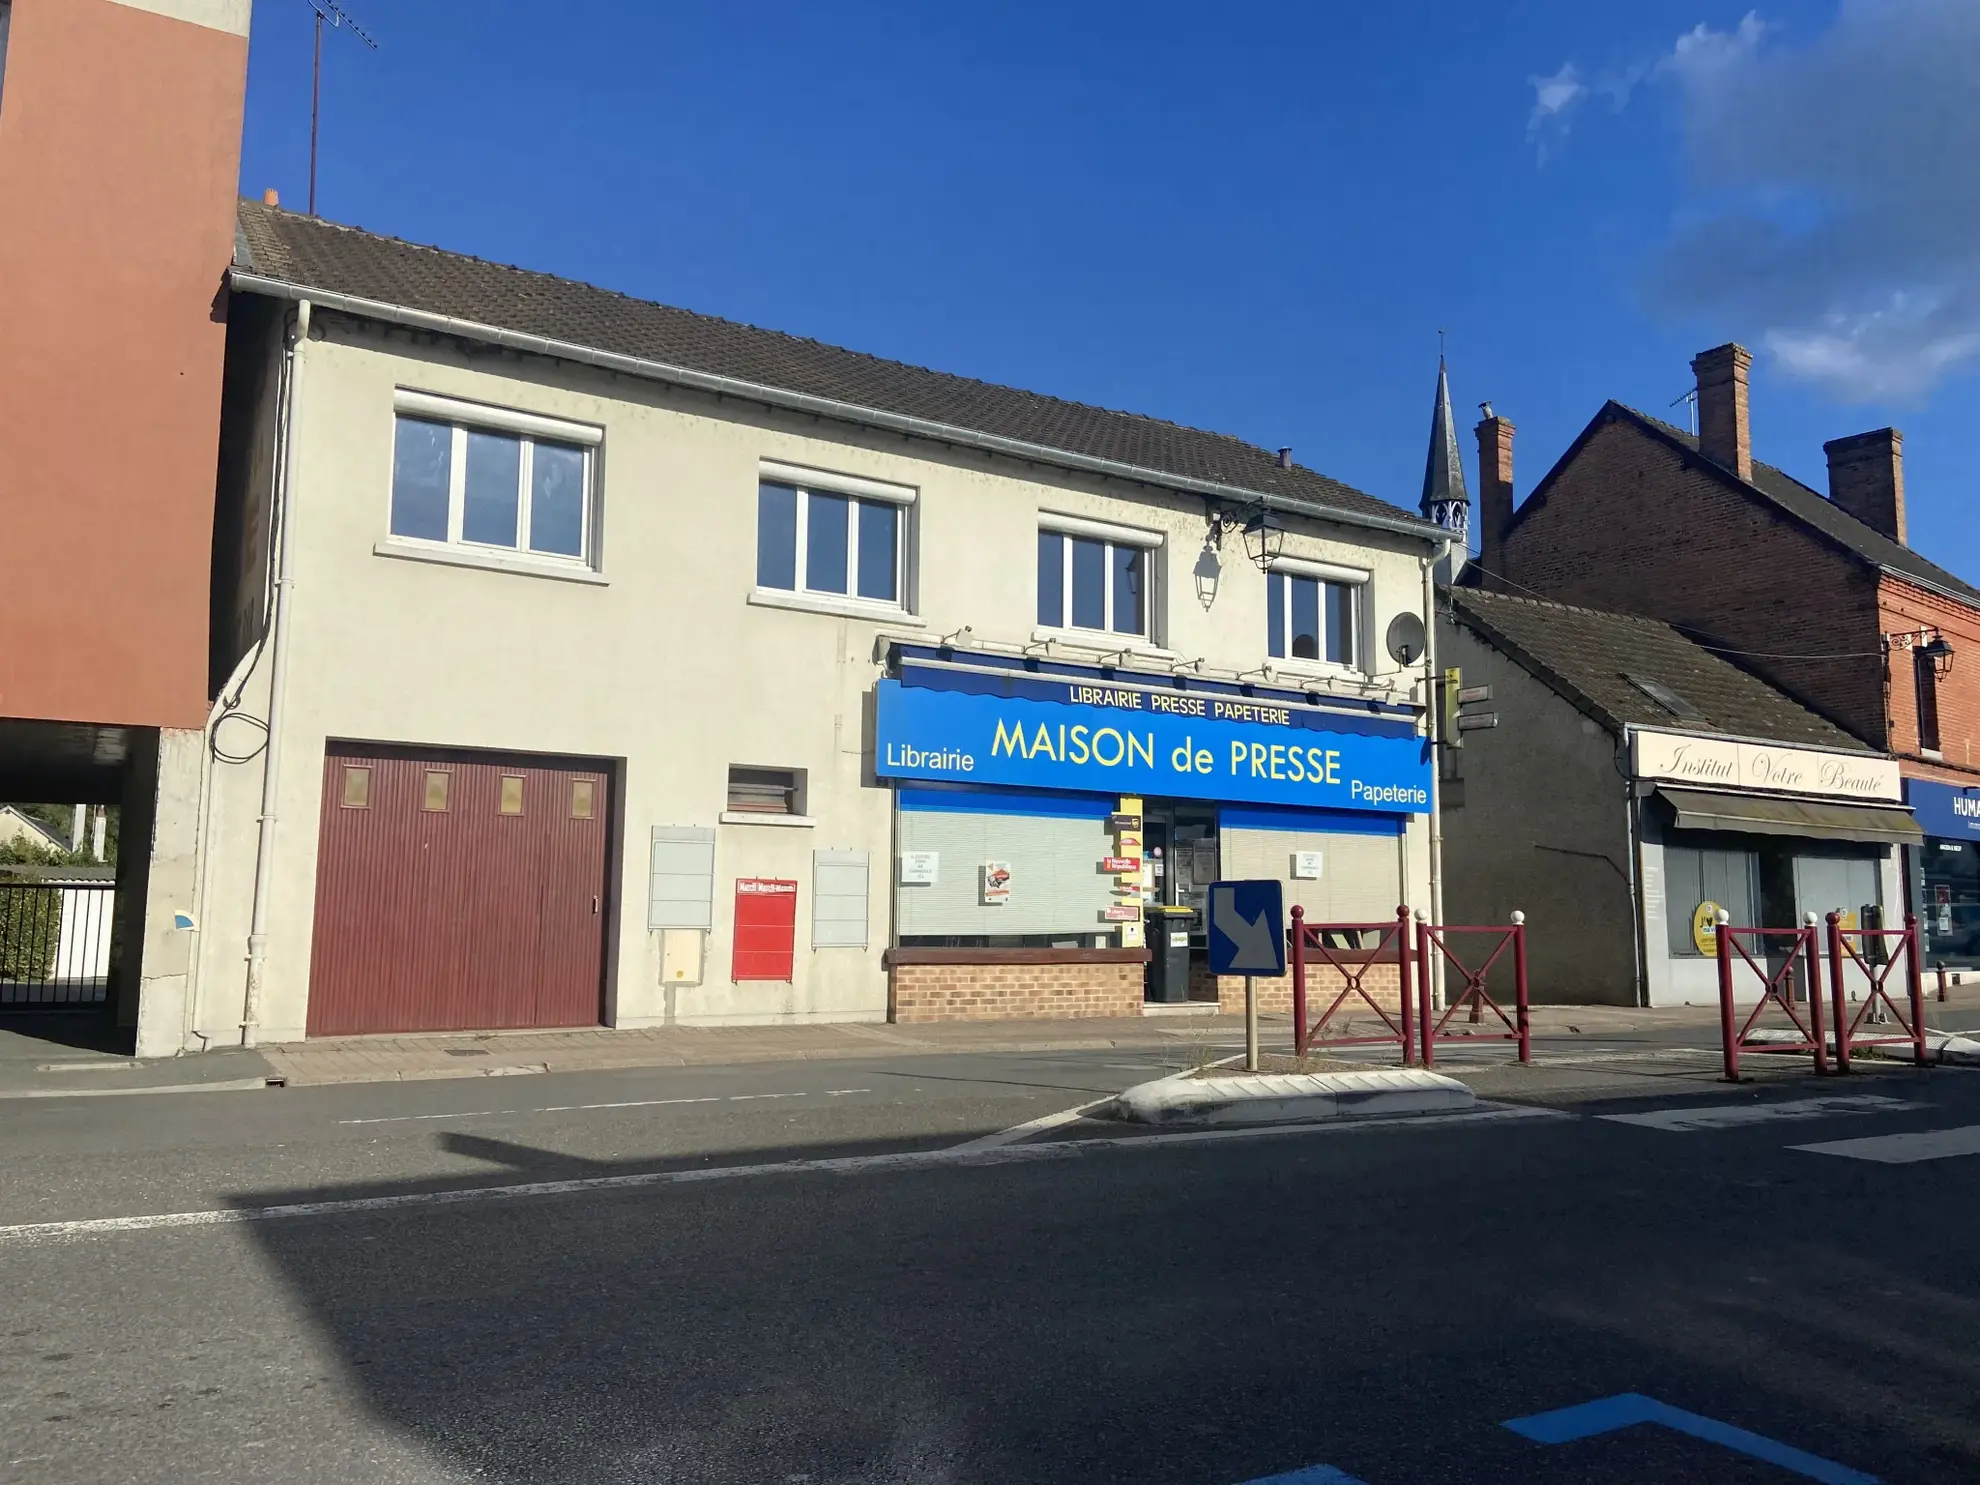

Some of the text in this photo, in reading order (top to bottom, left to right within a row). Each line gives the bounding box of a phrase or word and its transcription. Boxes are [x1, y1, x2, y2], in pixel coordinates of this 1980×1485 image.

[1069, 685, 1290, 725] LIBRAIRIE PRESSE PAPETERIE
[887, 743, 975, 772] Librairie
[991, 718, 1341, 785] MAISON de PRESSE
[1660, 743, 1884, 793] Institut Votre Beauté
[1351, 779, 1427, 805] Papeterie
